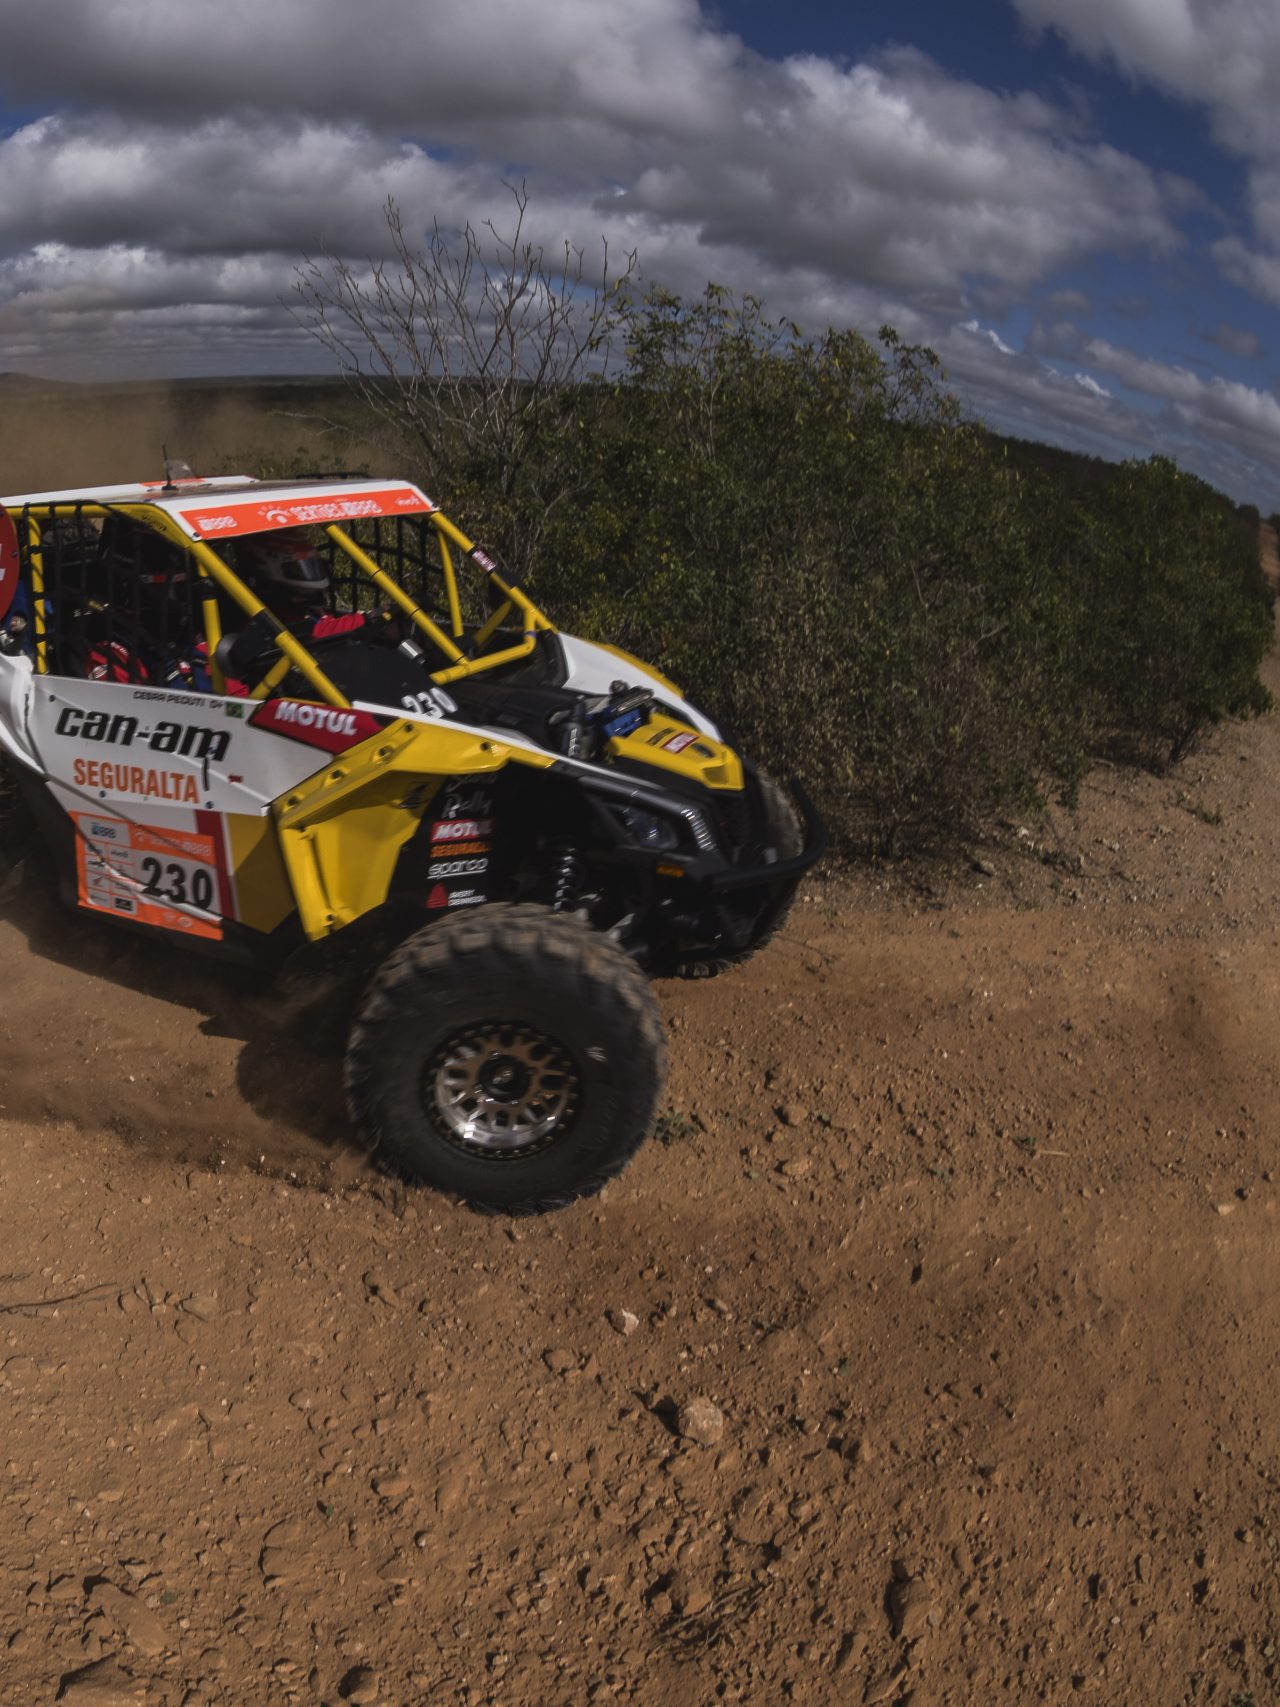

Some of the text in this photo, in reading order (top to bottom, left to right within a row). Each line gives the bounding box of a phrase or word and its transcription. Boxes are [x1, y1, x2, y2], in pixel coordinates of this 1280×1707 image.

[274, 701, 359, 737] MOTUL
[400, 686, 459, 720] 230
[55, 707, 231, 763] can-am
[73, 758, 200, 804] SEGURALTA
[140, 856, 214, 911] 230
[427, 858, 489, 880] sparco
